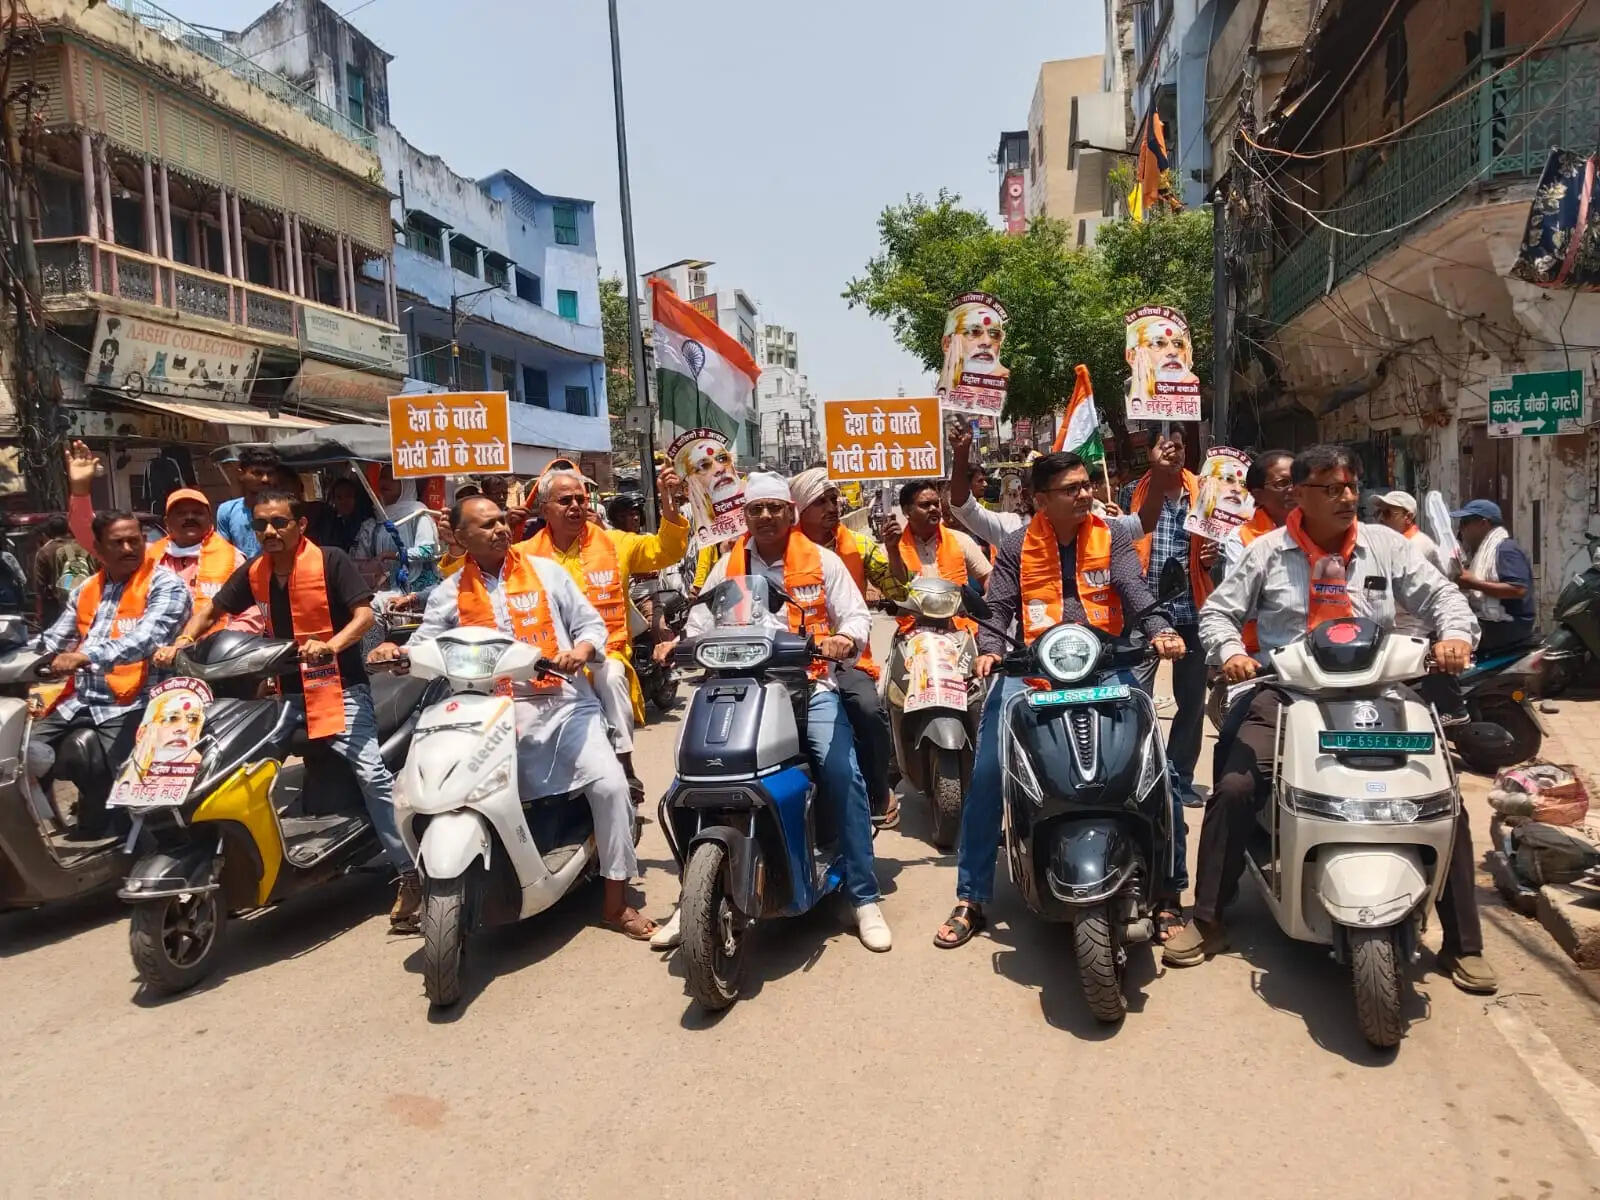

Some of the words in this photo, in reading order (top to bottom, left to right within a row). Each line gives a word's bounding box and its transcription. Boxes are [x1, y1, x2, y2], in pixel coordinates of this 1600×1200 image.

[126, 323, 169, 345] AASHI
[172, 331, 246, 359] COLLECTION
[408, 404, 431, 432] देश
[433, 402, 449, 430] के
[452, 400, 488, 430] वास्ते
[1523, 391, 1549, 412] चौकी
[843, 407, 868, 436] देश
[870, 406, 886, 435] के
[888, 405, 922, 435] वास्ते
[396, 440, 428, 469] मोदी
[430, 438, 451, 467] जी
[453, 437, 470, 466] के
[472, 437, 505, 466] रास्ते
[831, 443, 865, 473] मोदी
[866, 442, 887, 471] जी
[889, 442, 904, 470] के
[906, 440, 937, 470] रास्ते
[467, 719, 513, 775] electric
